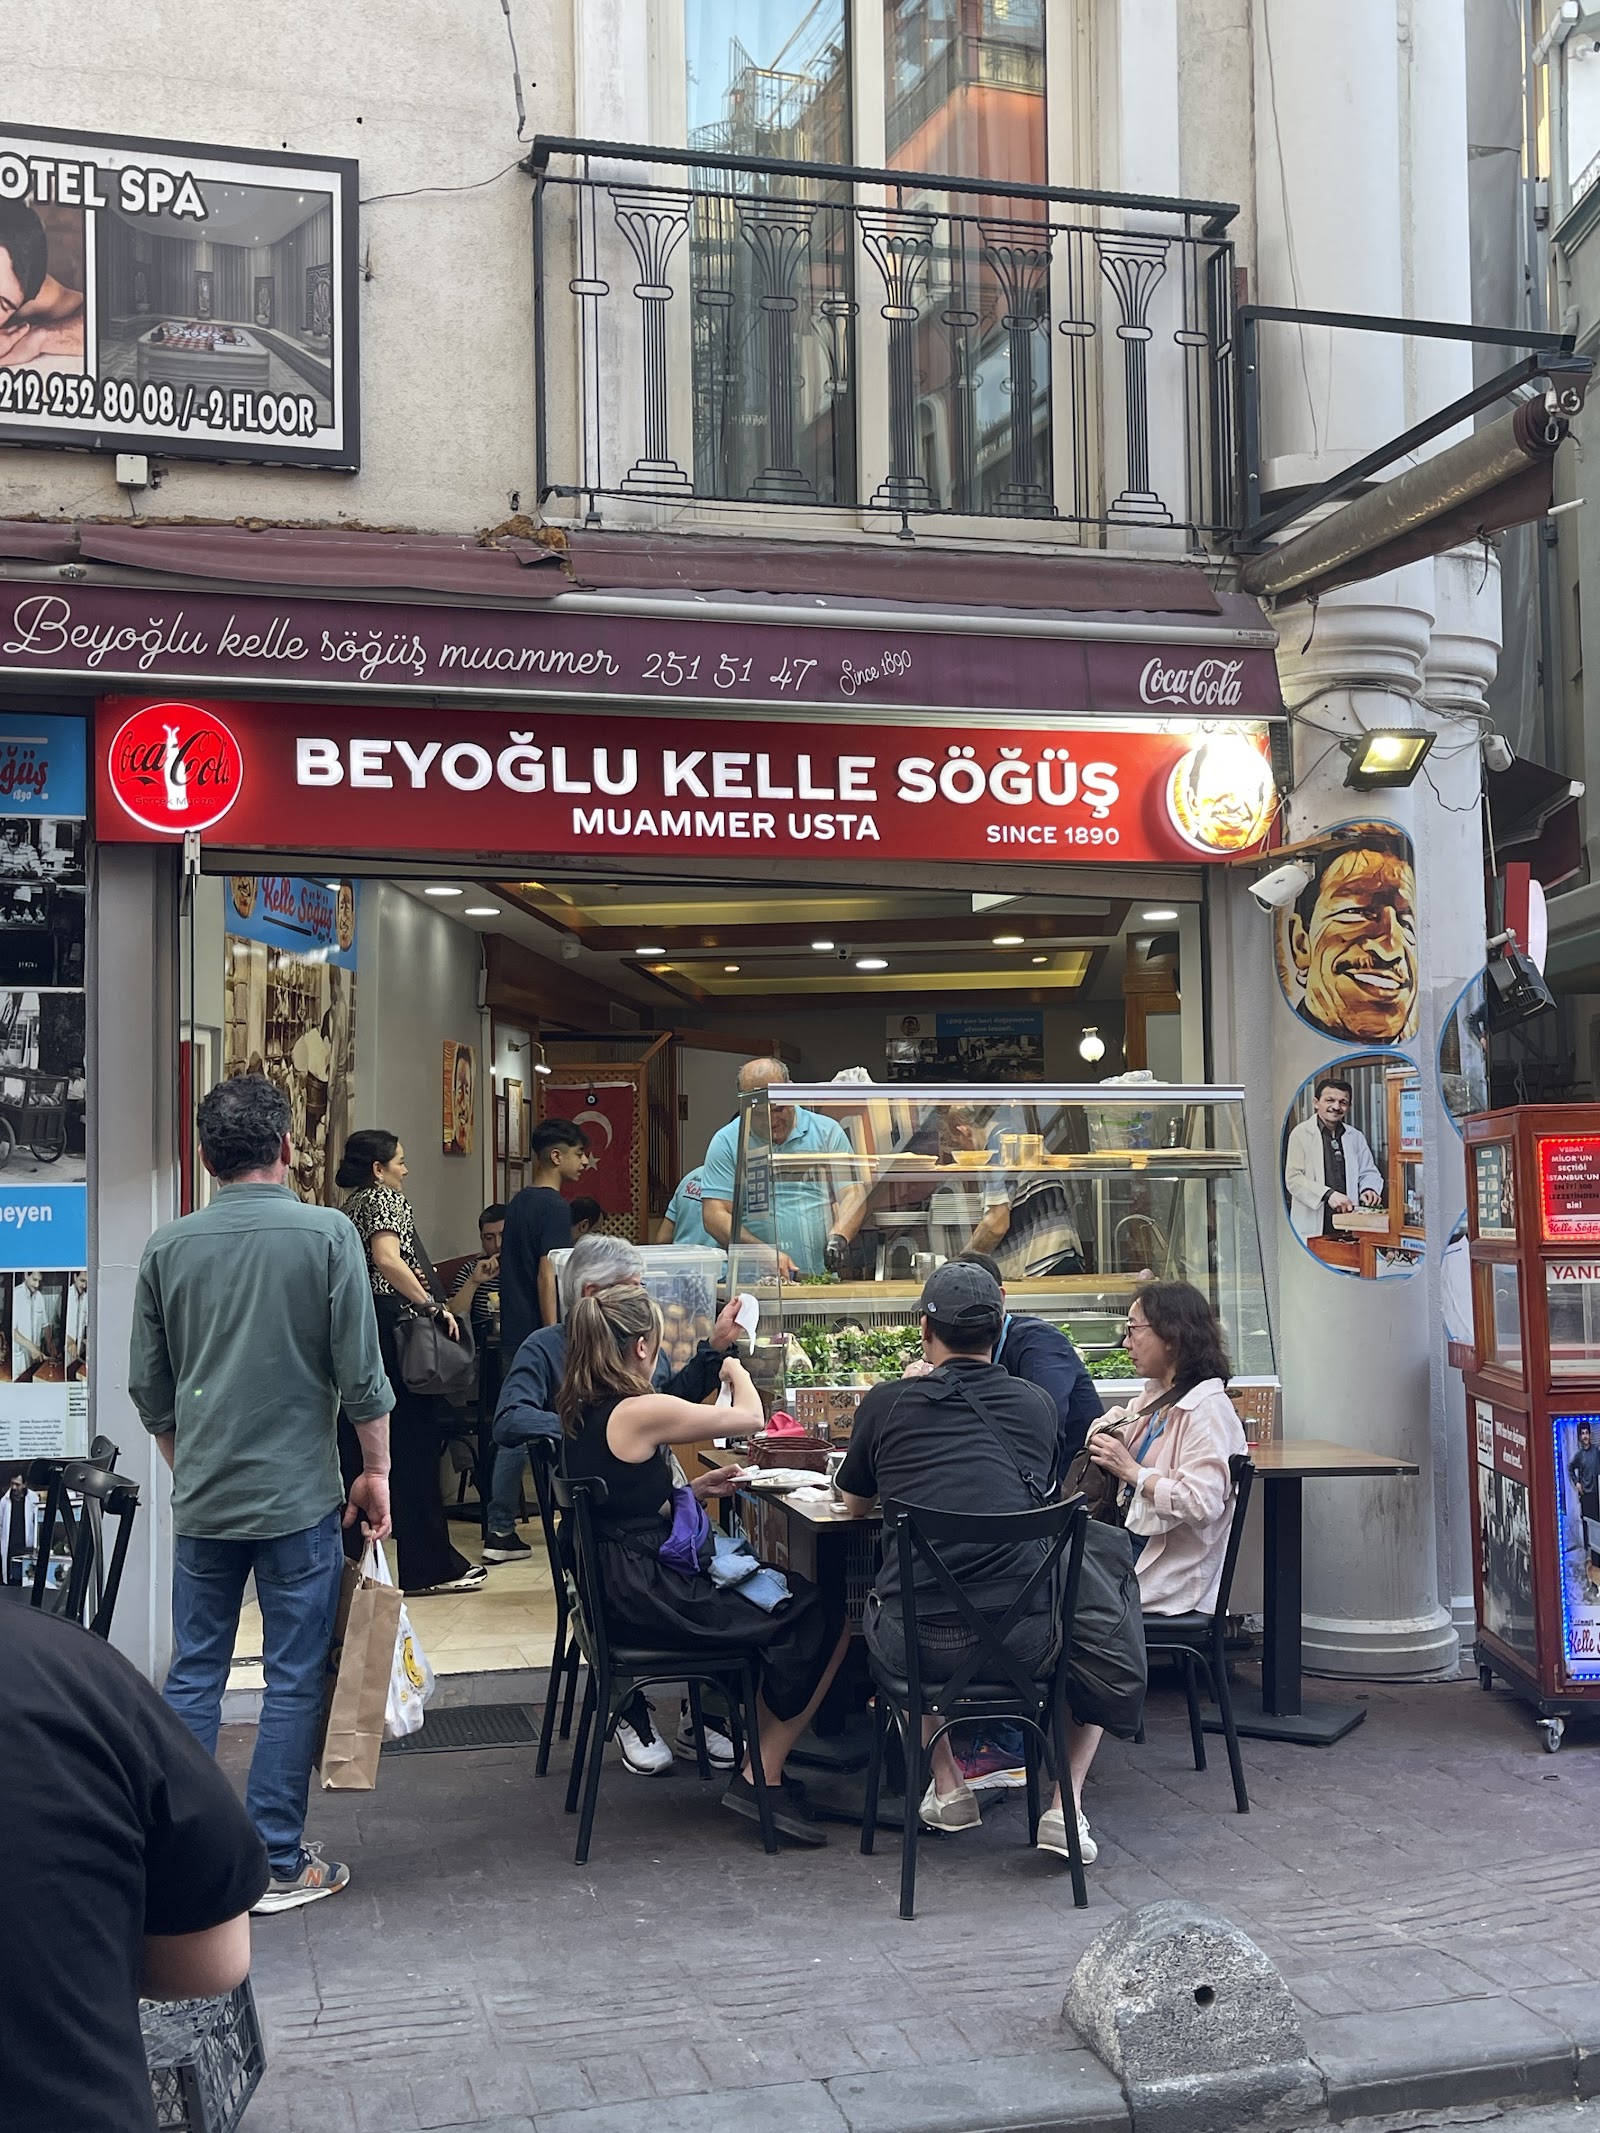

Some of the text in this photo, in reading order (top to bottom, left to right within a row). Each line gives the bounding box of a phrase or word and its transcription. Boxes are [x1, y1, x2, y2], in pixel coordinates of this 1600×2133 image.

[121, 169, 206, 217] SPA
[0, 372, 40, 410] 212
[50, 377, 95, 415] 252
[104, 382, 132, 419] 80
[143, 385, 173, 422] 08
[232, 393, 314, 433] FLOOR
[3, 595, 818, 691] Beyoğlu kelle söğüş muammer 251 51 47
[840, 649, 912, 696] Since 1890
[1138, 657, 1244, 706] Coca-Cola
[0, 744, 48, 796] ğüş
[118, 729, 232, 786] Coca-Cola
[296, 731, 1120, 819] BEYOĞLU KELLE SÖĞÜŞ
[572, 807, 881, 841] MUAMMER USTA
[986, 824, 1120, 845] SINCE 1890
[262, 876, 333, 939] Kelle Söğüş
[1551, 1154, 1593, 1162] MİLOR'UN
[1557, 1163, 1588, 1172] SEÇTİĞİ
[1546, 1173, 1600, 1182] İSTANBUL'UN
[0, 1205, 53, 1229] eyen
[1566, 1200, 1582, 1209] BİRİ
[1548, 1222, 1600, 1233] Kelle Söğü
[1568, 1629, 1595, 1654] Kelle
[304, 1867, 323, 1888] N
